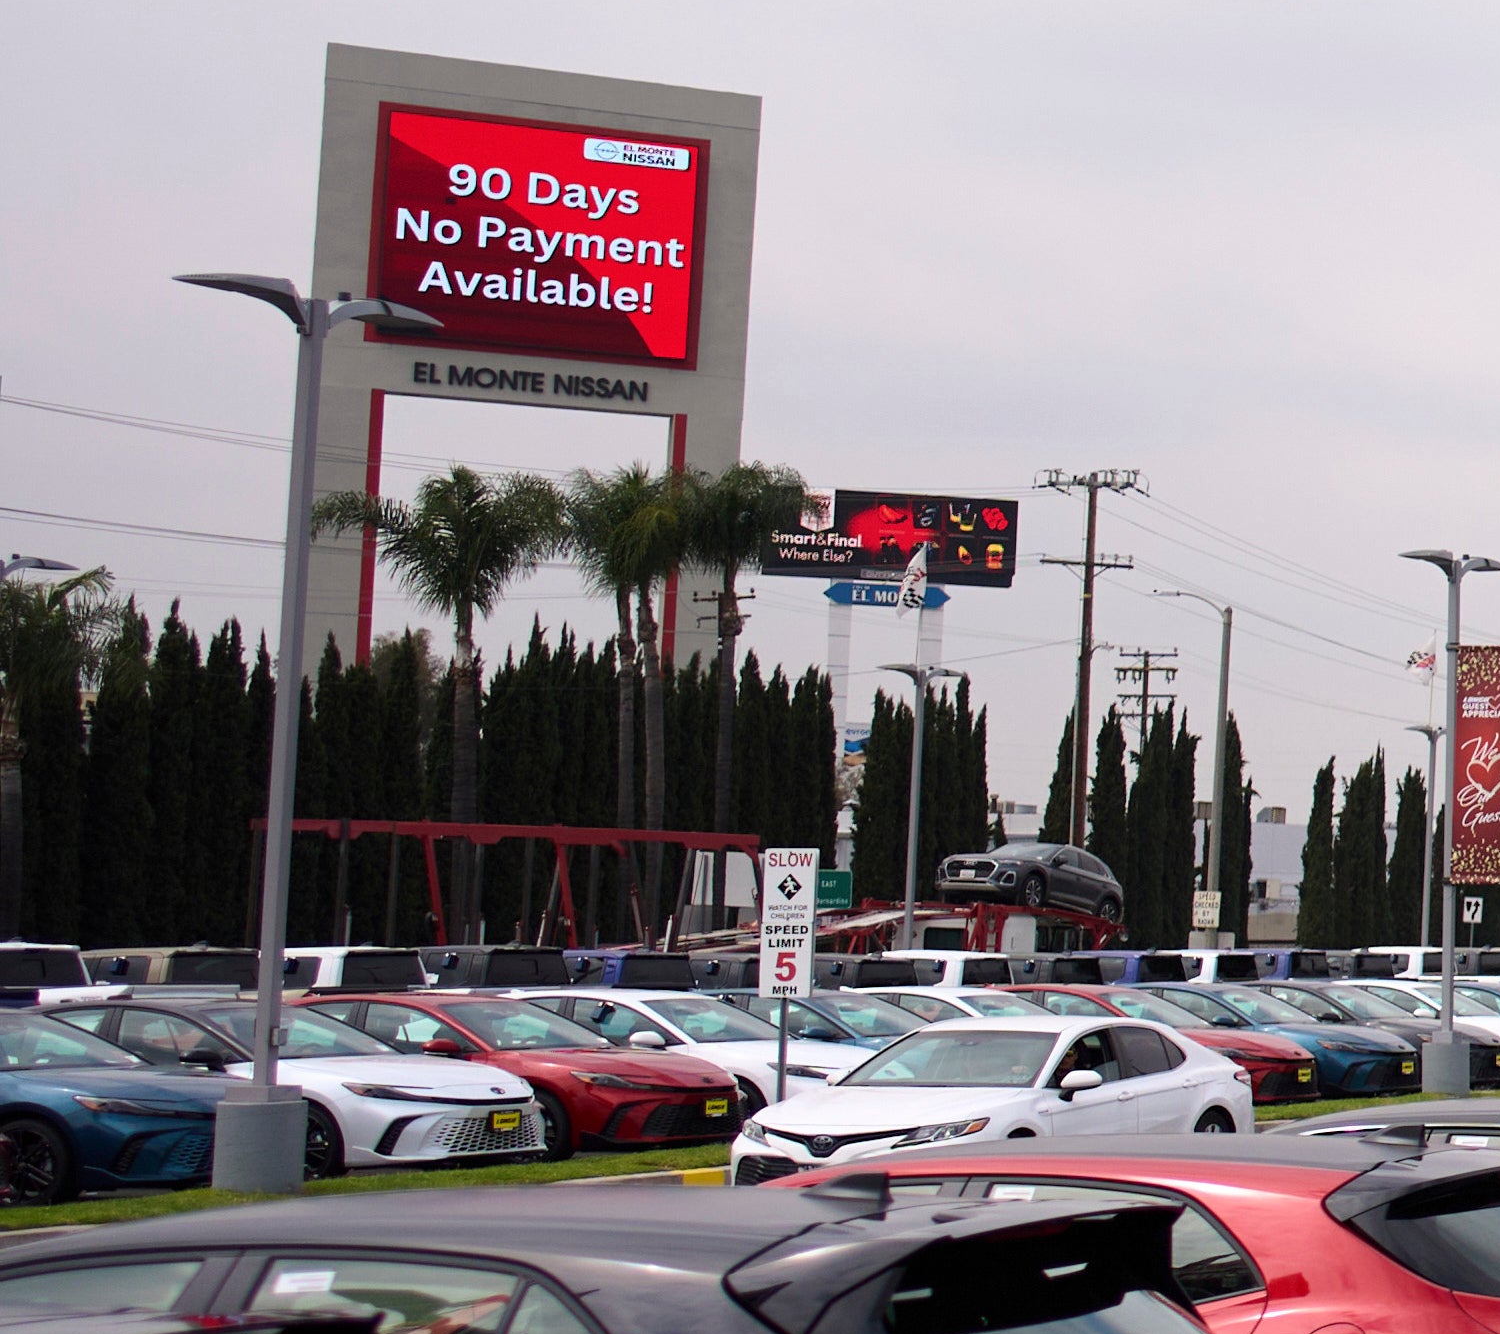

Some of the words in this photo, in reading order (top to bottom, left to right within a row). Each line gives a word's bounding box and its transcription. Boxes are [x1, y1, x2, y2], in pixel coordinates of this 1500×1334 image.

[623, 144, 635, 153] EL
[638, 145, 676, 157] MONTE
[622, 152, 675, 167] NISSAN
[448, 163, 512, 201] 90
[527, 172, 640, 219] Days
[396, 207, 462, 245] No
[477, 216, 685, 268] Payment
[417, 260, 653, 314] Available!
[413, 362, 440, 385] EL
[448, 365, 545, 393] MONTE
[553, 374, 648, 402] NISSAN
[779, 547, 819, 562] Where
[823, 549, 853, 563] Else?
[851, 590, 870, 603] EL
[1461, 732, 1499, 762] We
[768, 852, 813, 867] SLOW
[765, 925, 809, 935] SPEED
[768, 938, 805, 948] LIMIT
[774, 952, 798, 982] 5
[772, 986, 797, 996] MPH
